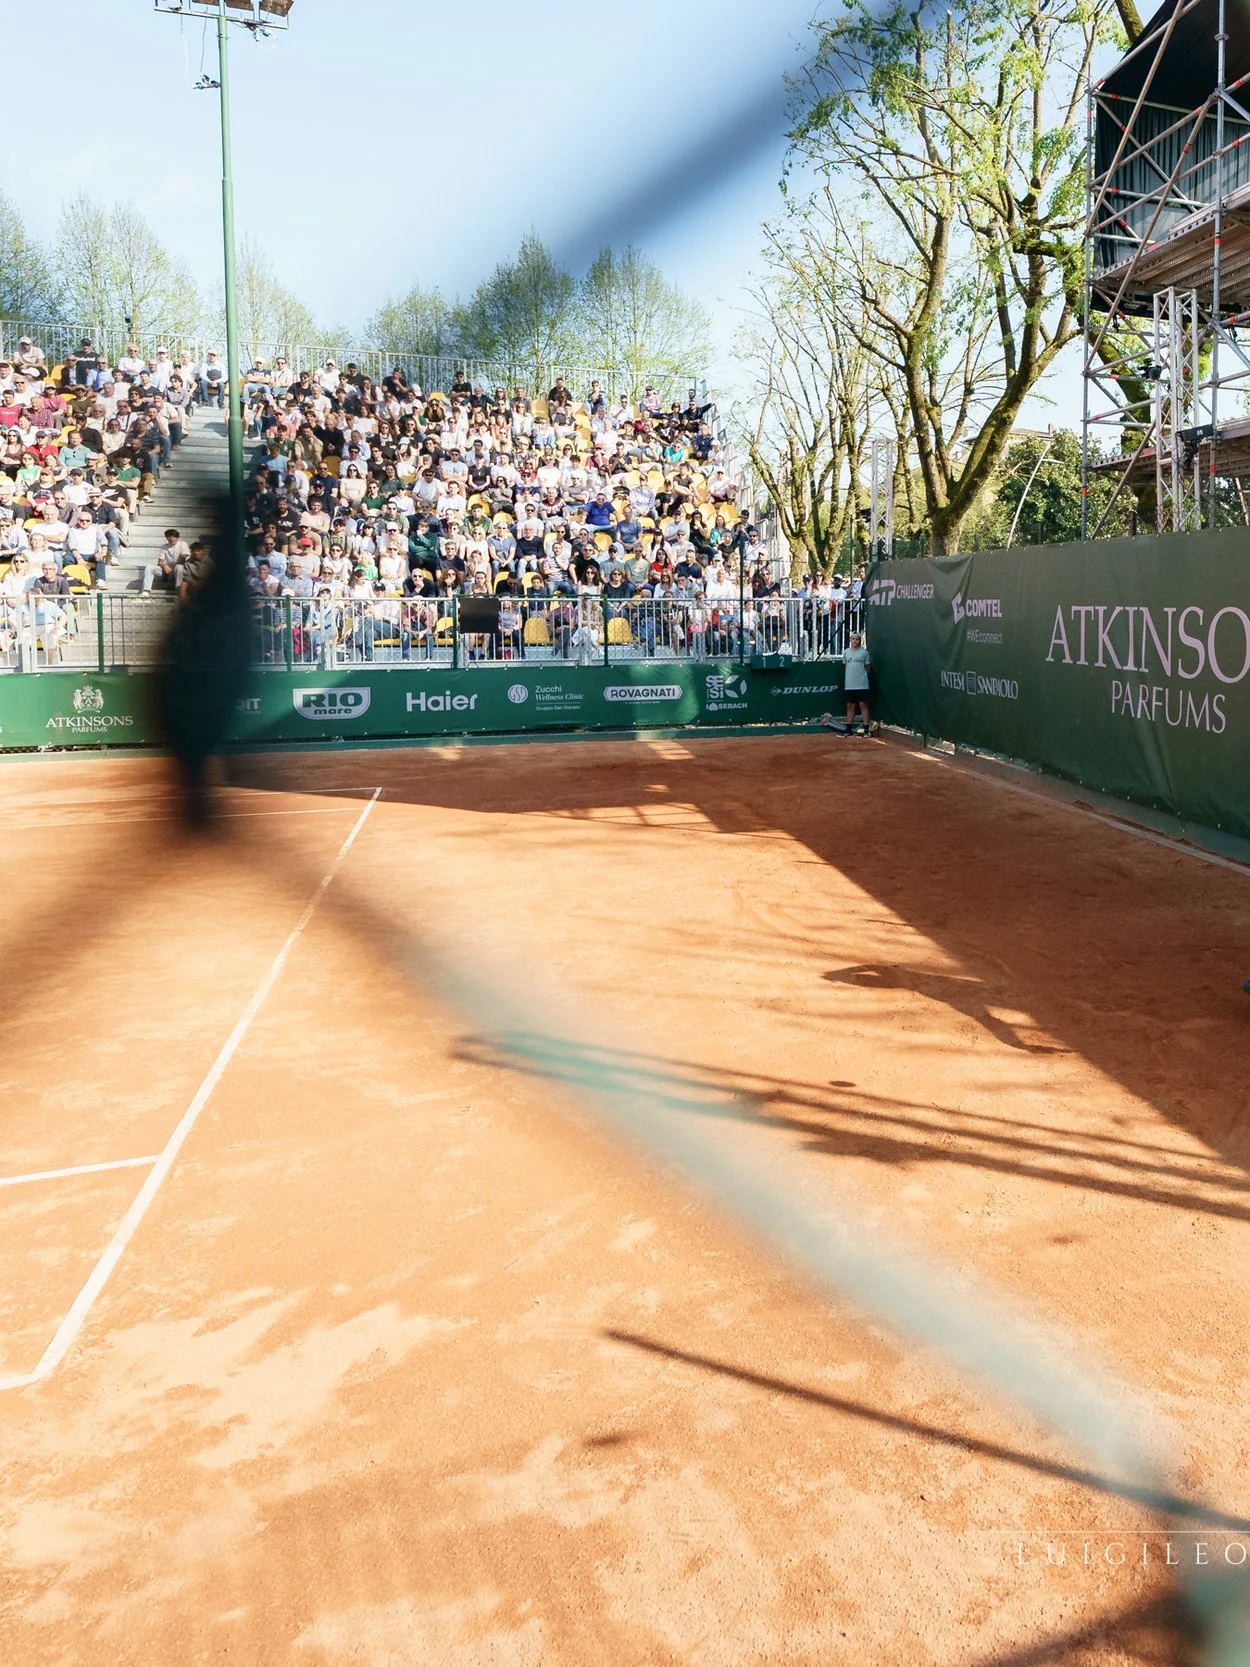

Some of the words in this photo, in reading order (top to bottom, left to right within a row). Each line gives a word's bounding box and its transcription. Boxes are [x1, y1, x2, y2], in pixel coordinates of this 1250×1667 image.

[868, 579, 896, 606] ATP
[896, 584, 934, 600] CHALLENGER
[966, 599, 1002, 617] COMTEL
[967, 629, 1003, 645] #WEconnect
[535, 685, 562, 693] Zucchi
[782, 685, 839, 695] DUNLOP
[941, 670, 965, 691] INTESA
[977, 675, 1019, 700] SANPAOLO
[302, 693, 363, 708] RIO
[535, 693, 564, 701] Wellness
[565, 692, 585, 700] Clinic
[610, 688, 676, 698] ROVAGNATI
[406, 690, 478, 712] Haier
[1110, 680, 1226, 734] PARFUMS
[45, 715, 134, 728] ATKINSONS
